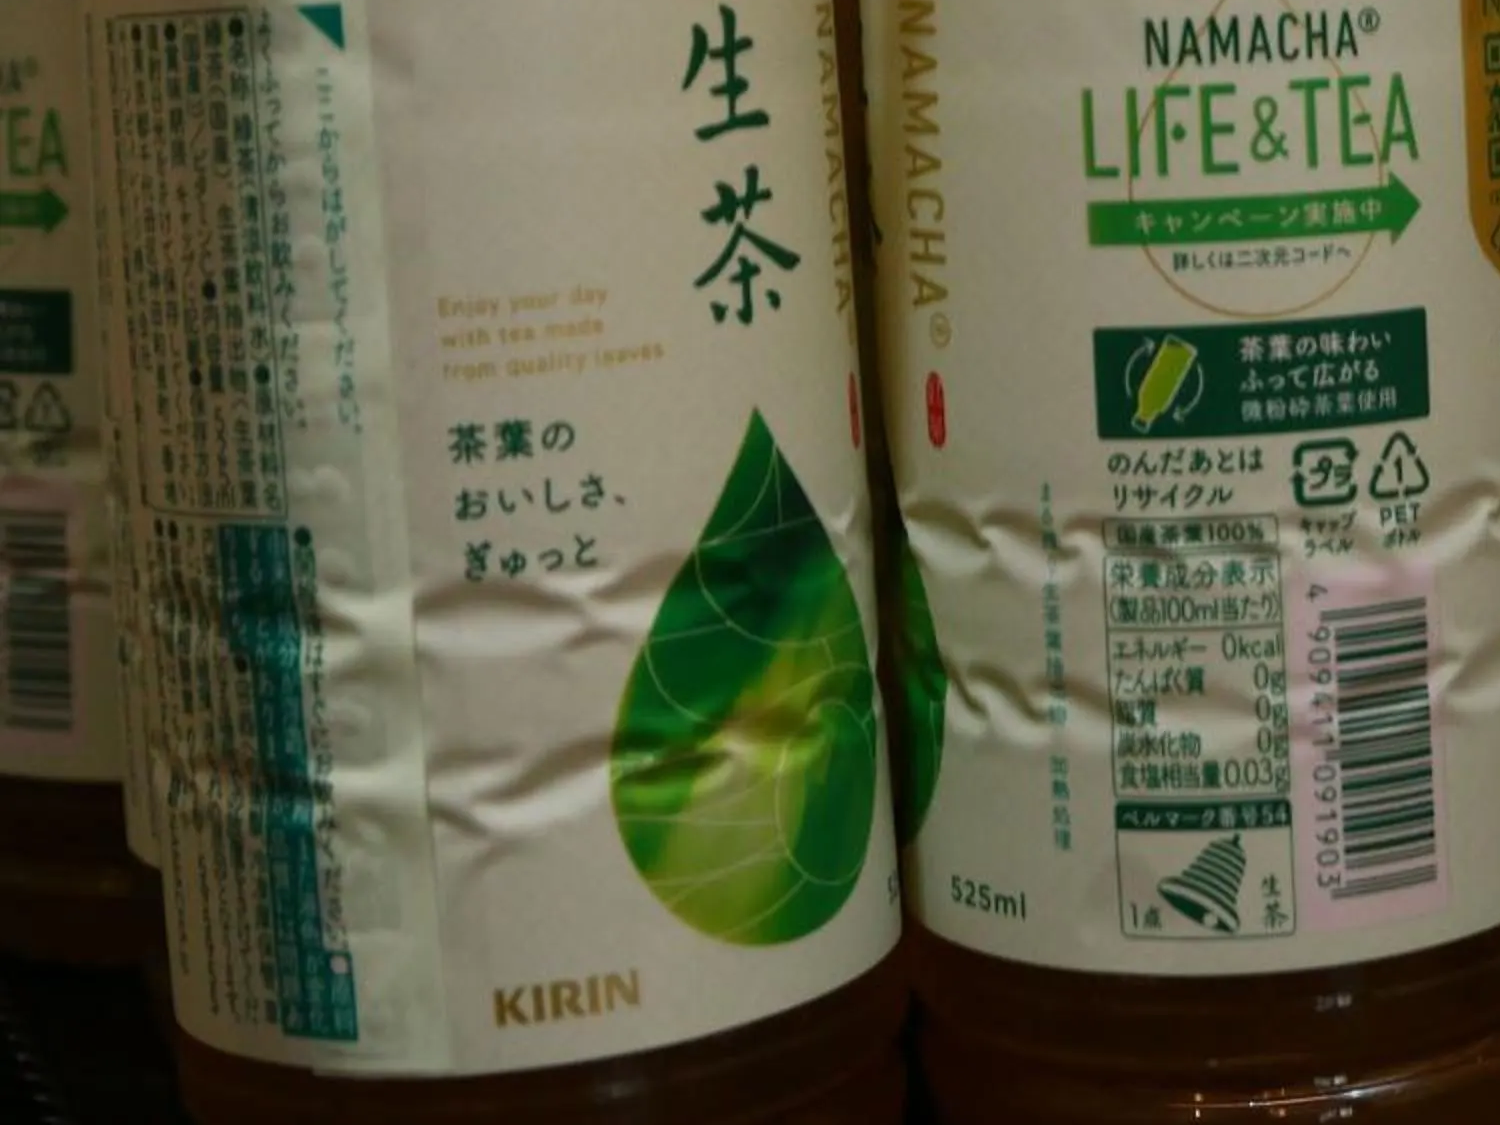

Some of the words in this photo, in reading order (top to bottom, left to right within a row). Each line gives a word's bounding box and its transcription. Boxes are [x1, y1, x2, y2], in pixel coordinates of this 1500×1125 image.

[682, 4, 801, 324] 生茶
[1133, 199, 1384, 235] キャンペーン実施中
[1172, 244, 1351, 272] 詳しくは二次元コードへ
[438, 296, 499, 319] Enjoy
[510, 293, 558, 314] your
[570, 283, 608, 308] day
[441, 328, 490, 349] with
[499, 327, 535, 345] tea
[545, 316, 604, 336] made
[1239, 331, 1392, 362] 茶葉の味わい
[442, 360, 497, 380] from
[506, 350, 587, 376] quality
[595, 342, 665, 366] leaves
[1239, 363, 1380, 393] ふって広がる
[448, 418, 575, 466] 茶葉の
[1108, 447, 1263, 475] のんだあとは
[455, 474, 627, 522] おいしさ、
[1113, 482, 1233, 510] リサイクル
[1379, 504, 1421, 528] PET
[1117, 522, 1263, 543] 国産茶葉100%
[464, 534, 598, 582] ぎゅっと
[1109, 561, 1275, 590] 栄養成分表示
[1112, 637, 1207, 662] エネルギー
[1221, 634, 1284, 661] 0kcal
[1112, 668, 1206, 693] たんぱく質
[1254, 666, 1287, 694] 0g
[1116, 701, 1157, 724] 脂質
[1255, 698, 1288, 726] 0g
[1117, 734, 1201, 758] 炭水化物
[1256, 730, 1289, 757] 0g
[1119, 761, 1220, 789] 食塩相当量
[951, 876, 1027, 921] 525ml
[493, 968, 642, 1028] KIRIN
